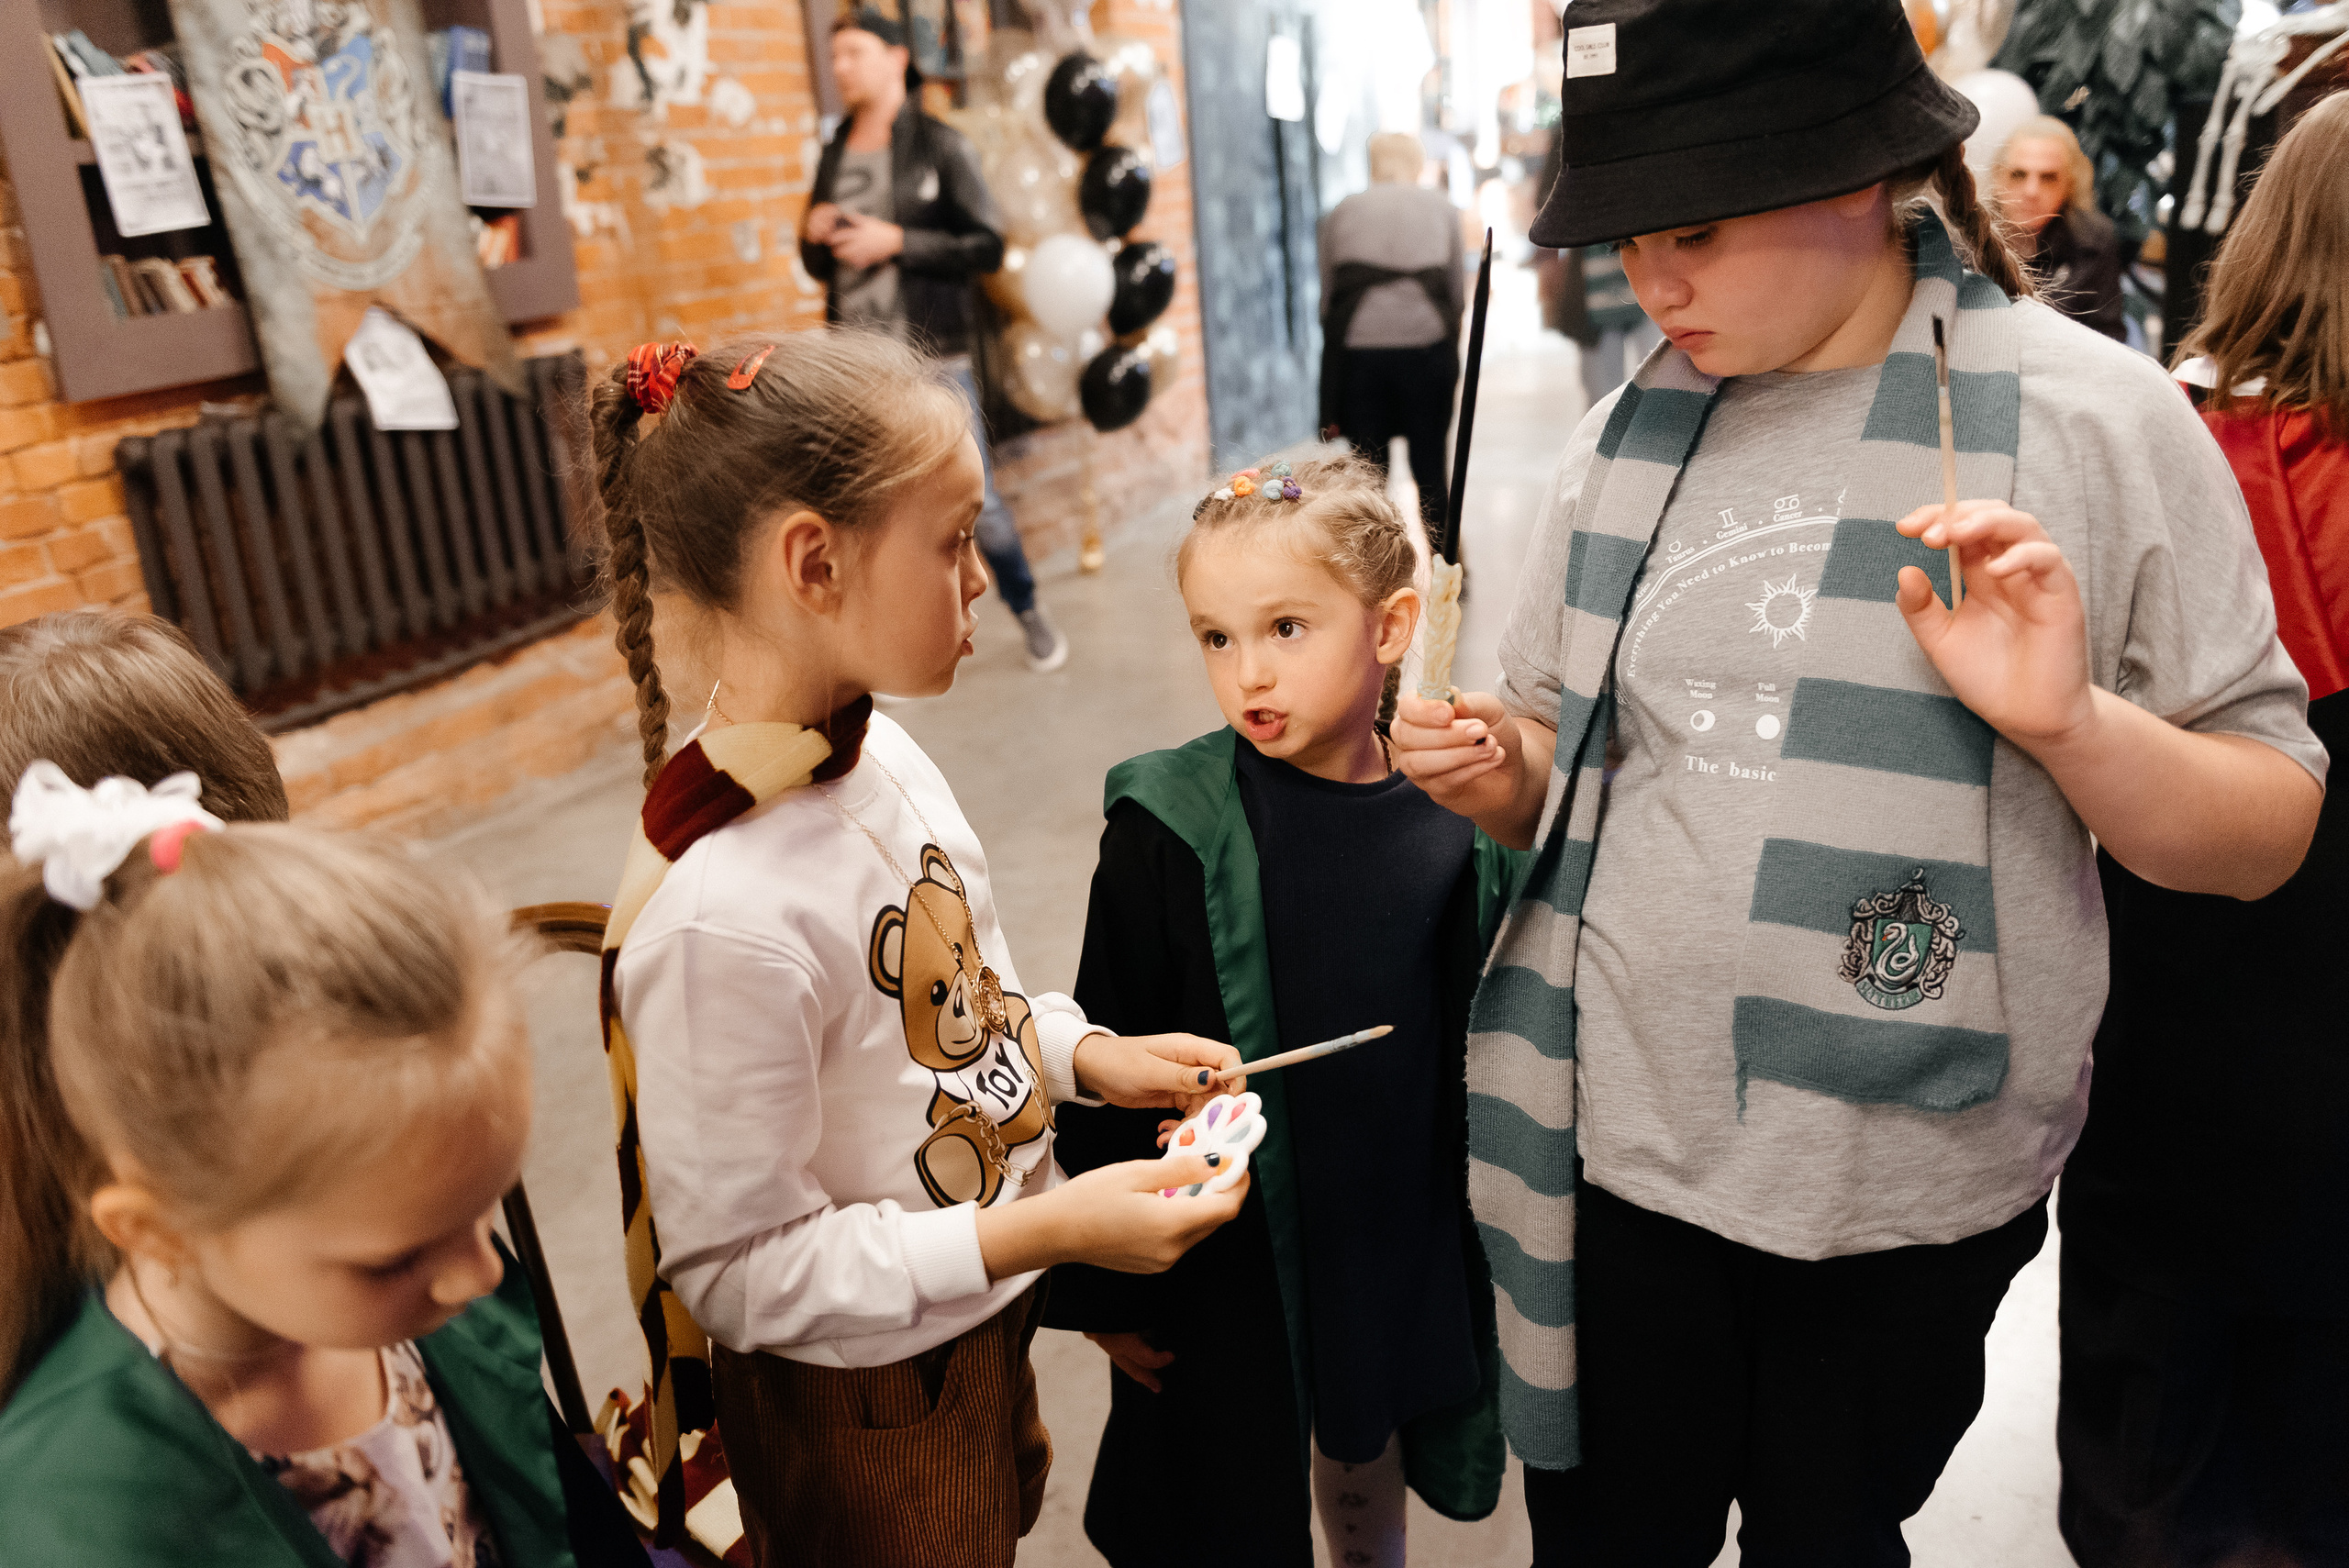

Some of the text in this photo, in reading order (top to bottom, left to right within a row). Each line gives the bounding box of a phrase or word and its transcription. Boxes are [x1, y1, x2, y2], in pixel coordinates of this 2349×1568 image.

[1773, 511, 1802, 522] Cancer
[1716, 523, 1748, 539] Gemini
[1665, 546, 1696, 564] Taurus
[1627, 610, 1660, 678] Everything
[1656, 590, 1679, 610] You
[1676, 569, 1709, 592] Need
[1712, 563, 1726, 574] to
[1728, 550, 1767, 568] Know
[1770, 547, 1785, 556] to
[1685, 679, 1717, 690] Waxing
[1757, 682, 1776, 692] Full
[1689, 690, 1713, 699] Moon
[1755, 693, 1780, 703] Moon
[1685, 755, 1776, 782] The basic
[975, 1042, 1025, 1111] TOY
